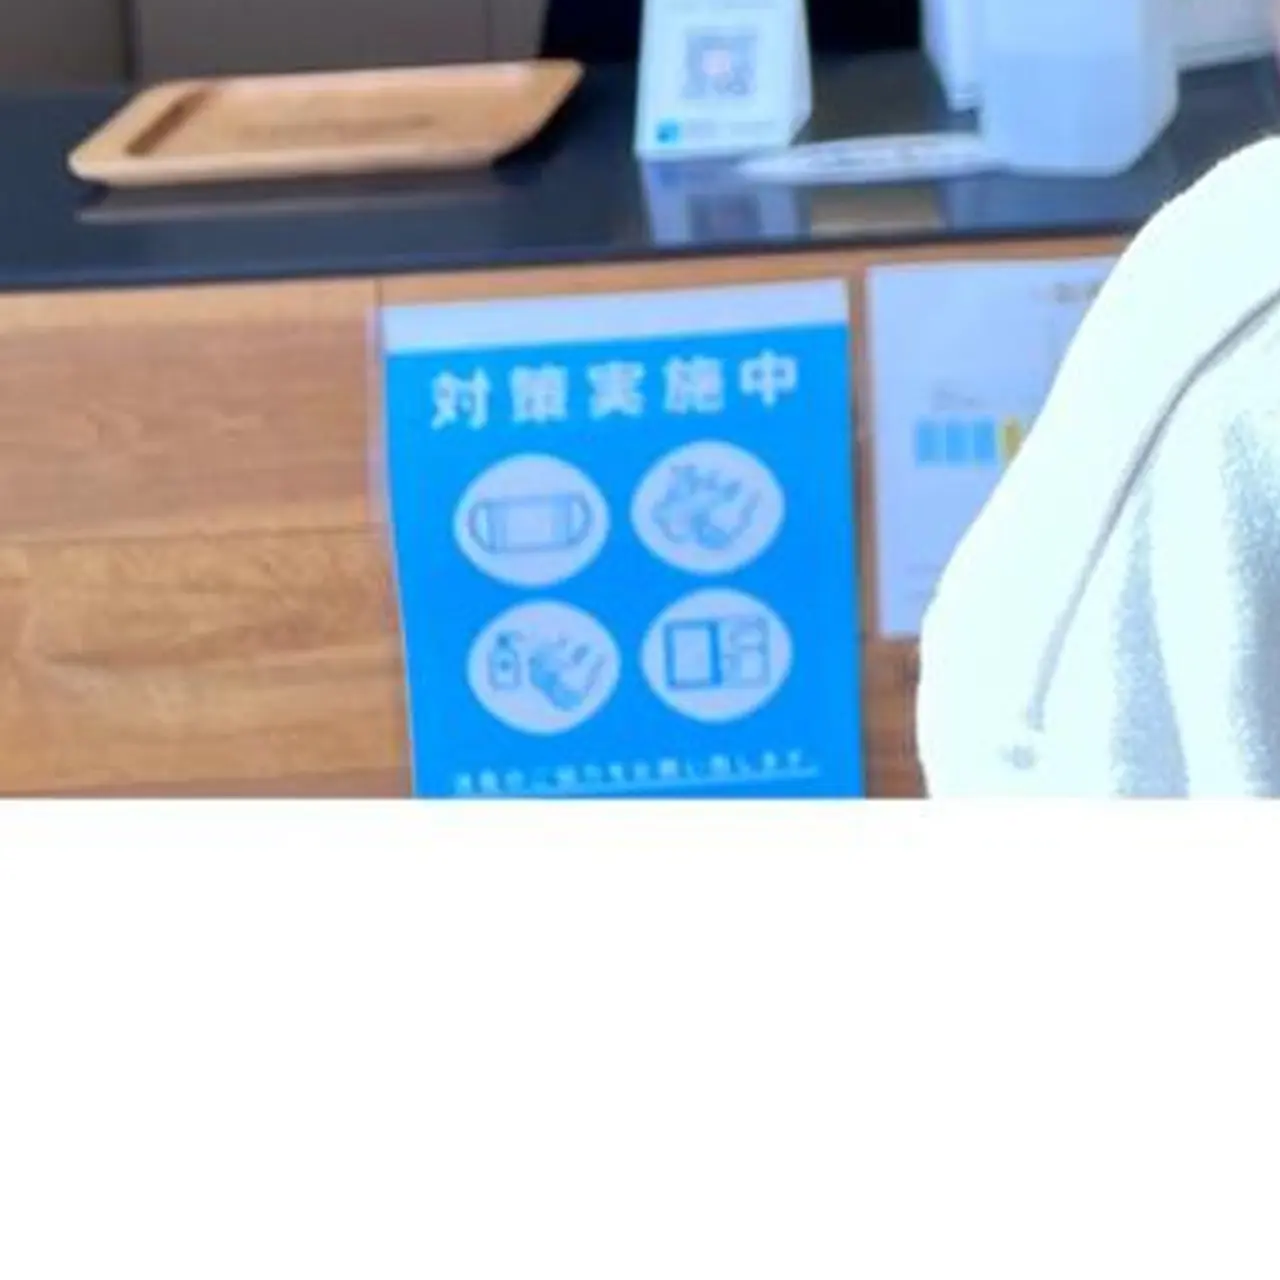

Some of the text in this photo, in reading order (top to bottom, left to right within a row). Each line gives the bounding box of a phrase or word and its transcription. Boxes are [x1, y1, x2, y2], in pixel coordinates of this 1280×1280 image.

[430, 349, 799, 430] 対策実施中
